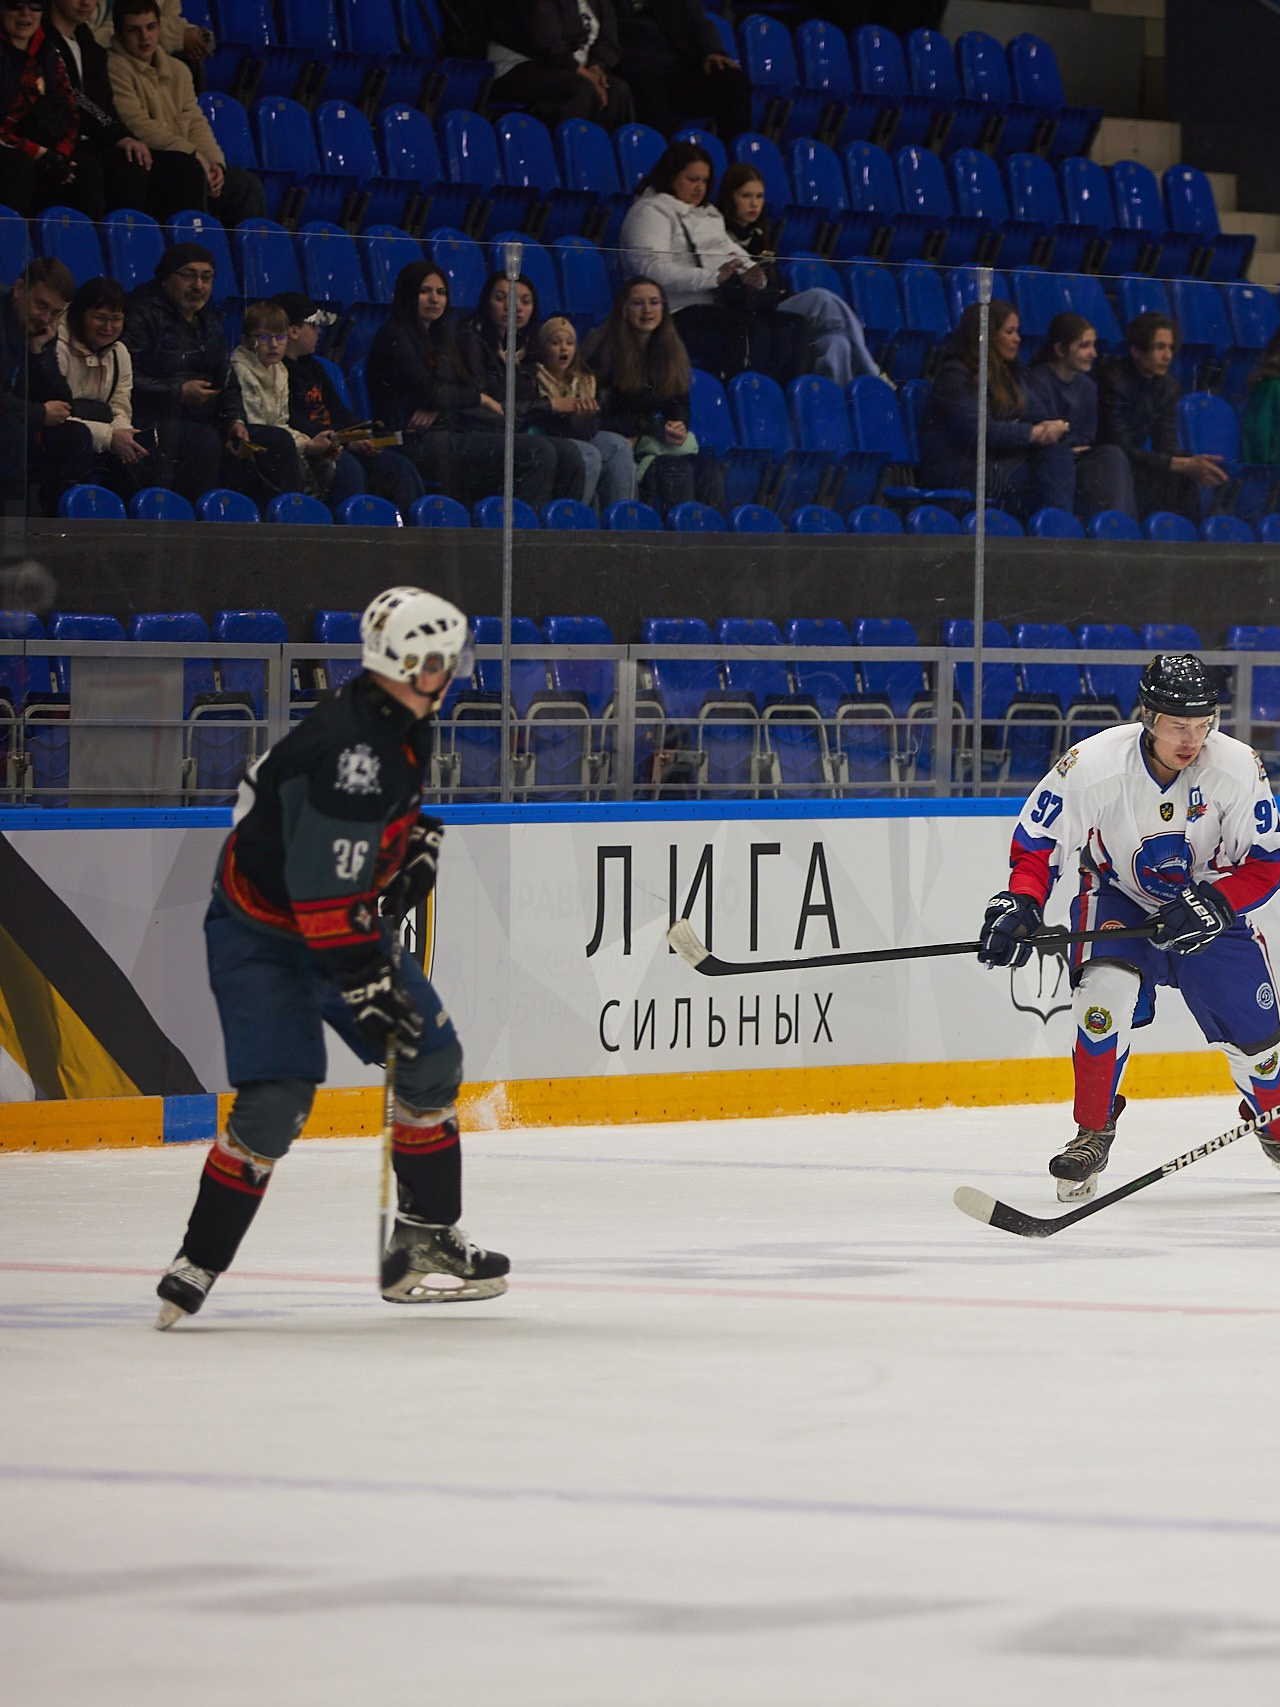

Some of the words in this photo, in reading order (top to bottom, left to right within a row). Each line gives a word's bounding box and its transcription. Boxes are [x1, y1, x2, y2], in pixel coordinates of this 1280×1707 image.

[1030, 789, 1064, 829] 97
[332, 838, 370, 881] 36
[585, 841, 842, 958] ЛИГА
[598, 991, 834, 1053] СИЛЬНЫХ
